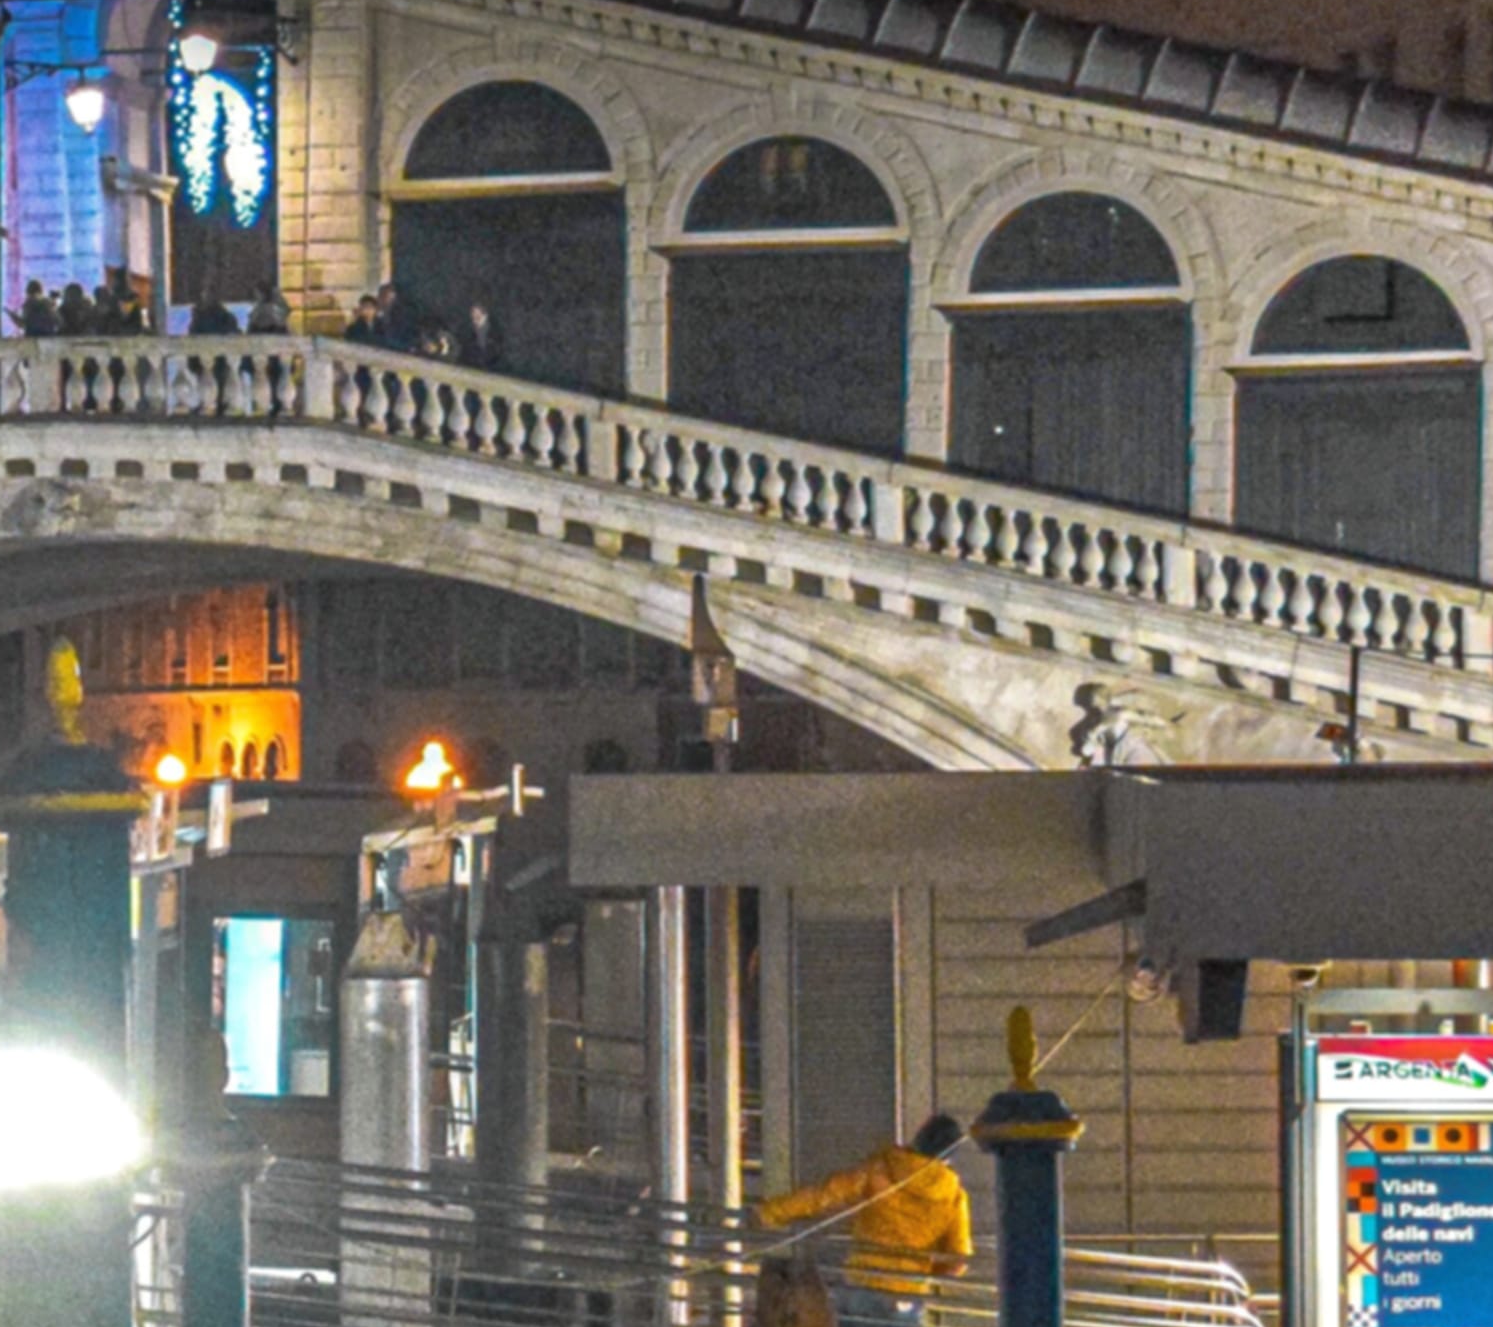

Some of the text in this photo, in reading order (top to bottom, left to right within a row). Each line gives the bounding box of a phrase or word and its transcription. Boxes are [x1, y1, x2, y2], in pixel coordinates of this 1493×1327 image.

[1381, 1180, 1438, 1195] Visita
[1381, 1225, 1475, 1242] delle navi
[1382, 1248, 1443, 1266] Aperto
[1382, 1271, 1420, 1286] tutti
[1391, 1295, 1442, 1312] giorni
